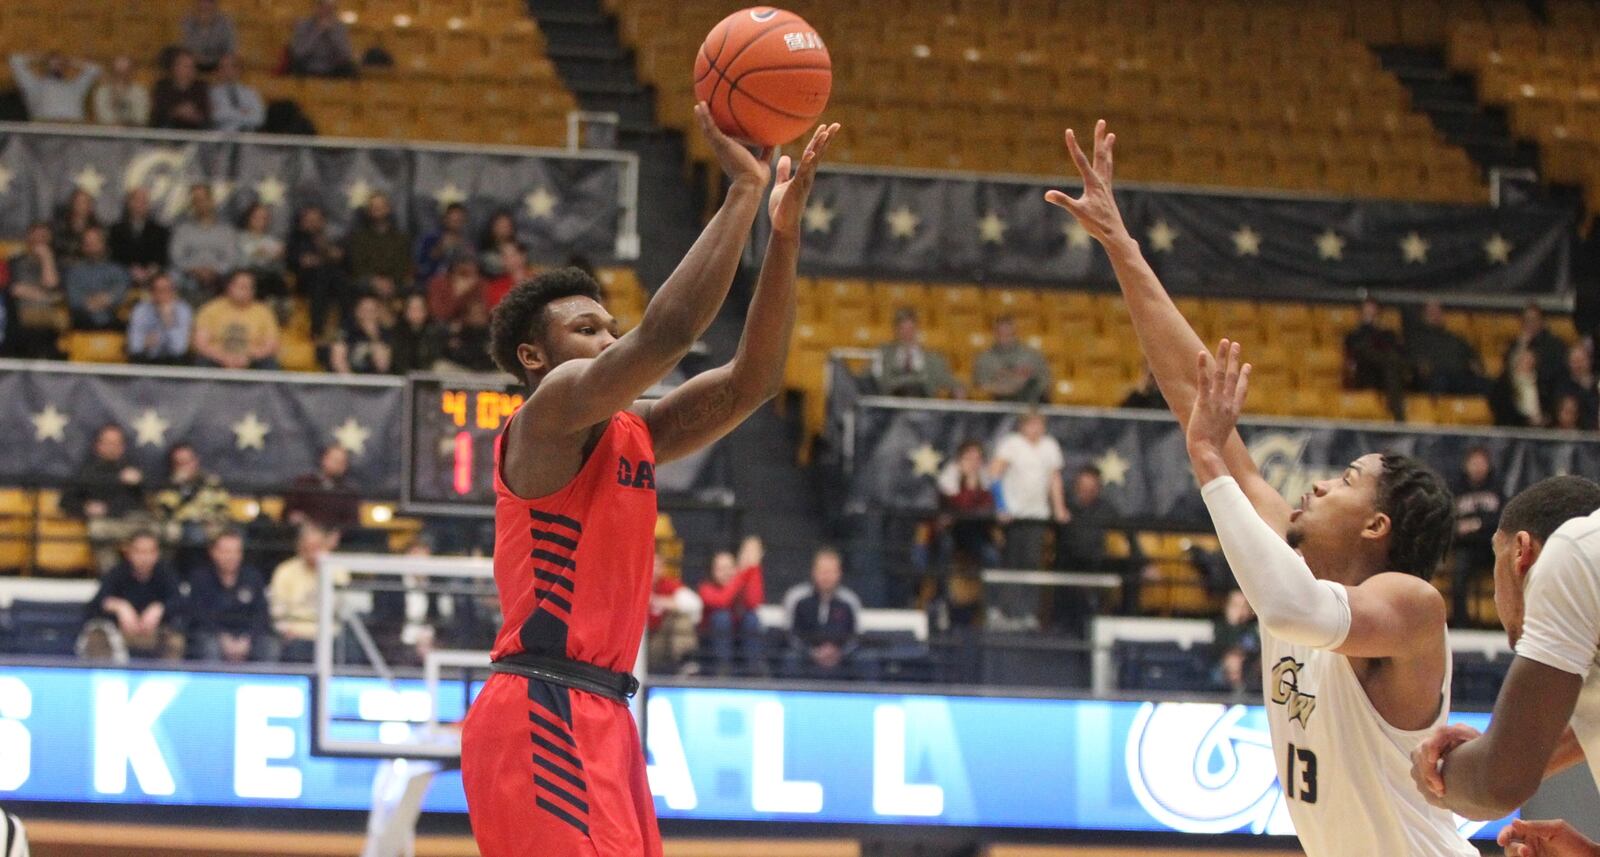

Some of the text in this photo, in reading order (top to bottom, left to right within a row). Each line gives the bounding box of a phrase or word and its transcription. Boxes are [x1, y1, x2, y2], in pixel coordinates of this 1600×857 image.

[442, 390, 467, 427] 4
[617, 455, 656, 490] DA
[1287, 742, 1318, 804] 13
